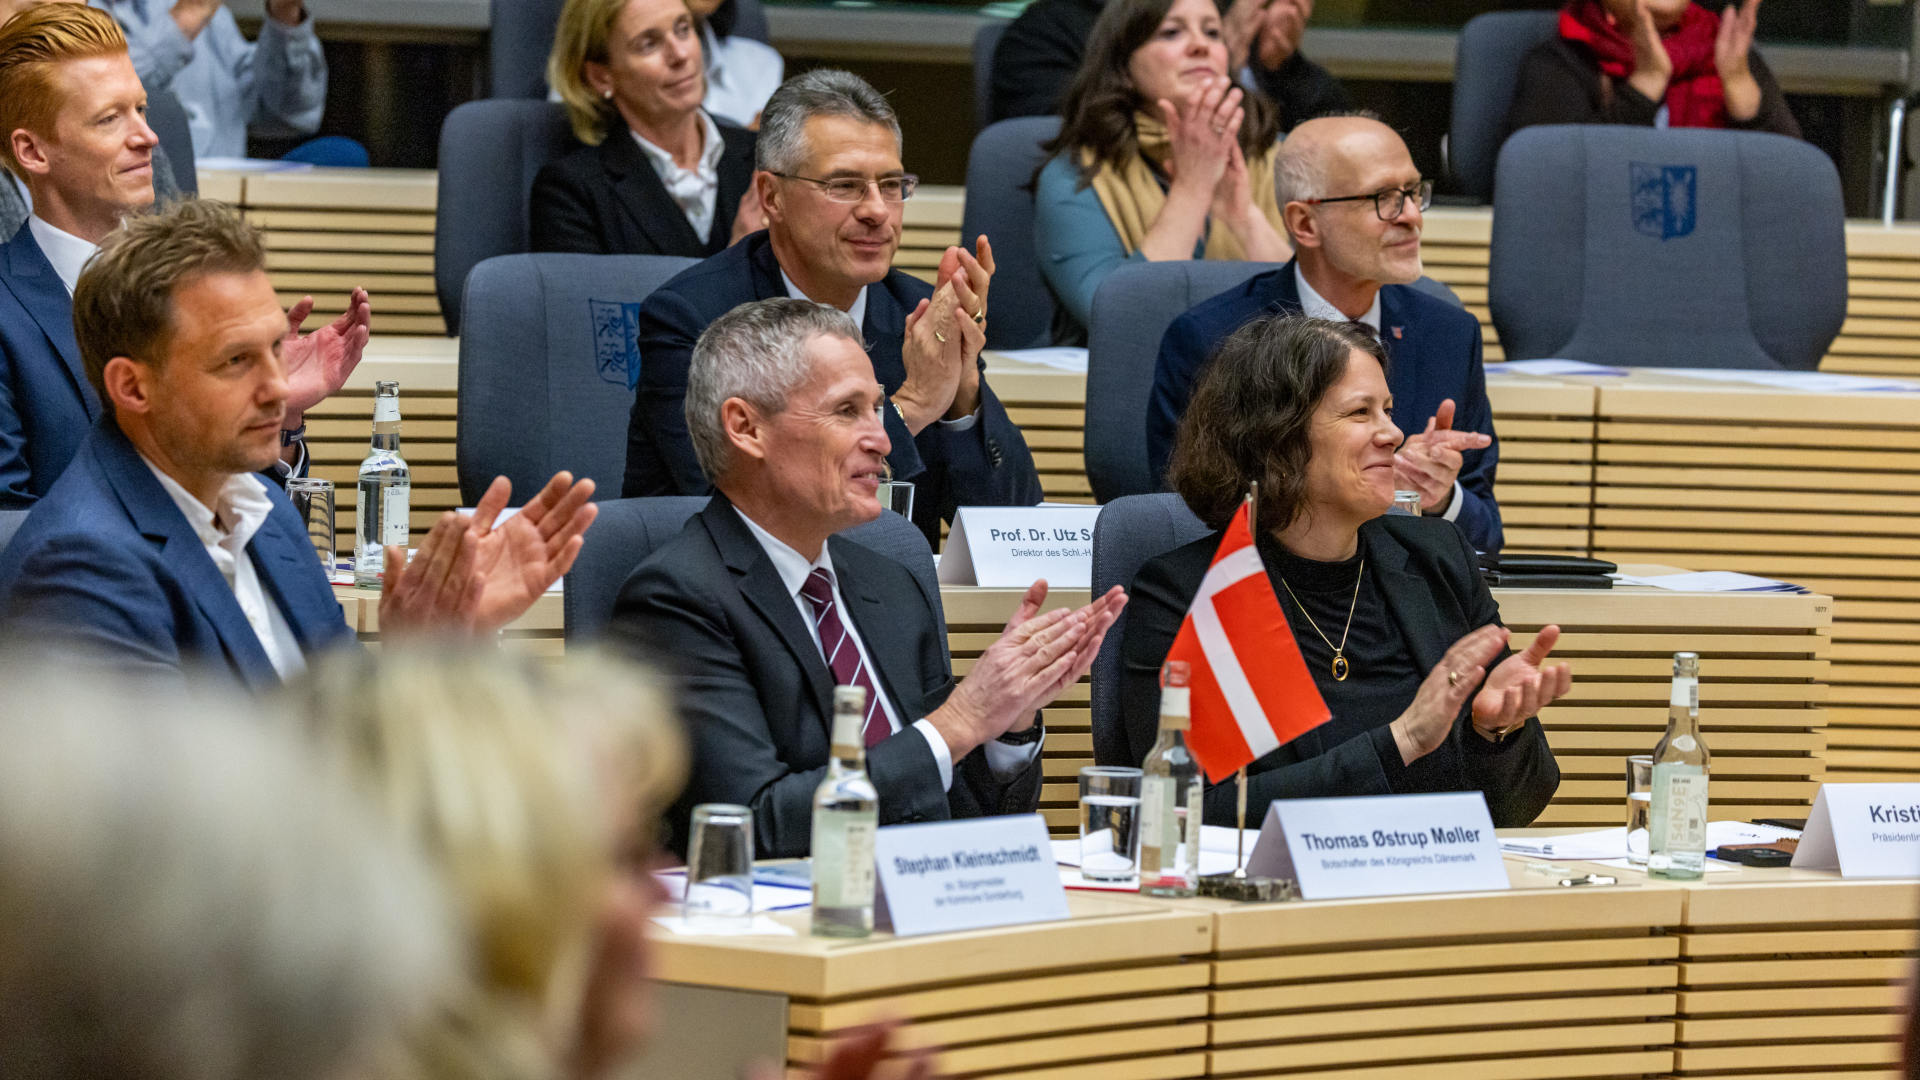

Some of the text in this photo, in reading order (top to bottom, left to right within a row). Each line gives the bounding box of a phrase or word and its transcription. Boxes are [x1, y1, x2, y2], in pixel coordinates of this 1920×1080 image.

[990, 528, 1026, 541] Prof.
[1028, 528, 1050, 541] Dr.
[1053, 528, 1078, 541] Utz
[1011, 548, 1043, 557] Direktor
[1045, 548, 1060, 557] des
[1300, 826, 1480, 850] Thomas Østrup Møller
[893, 845, 1041, 876] Stephan Kleinschmidt
